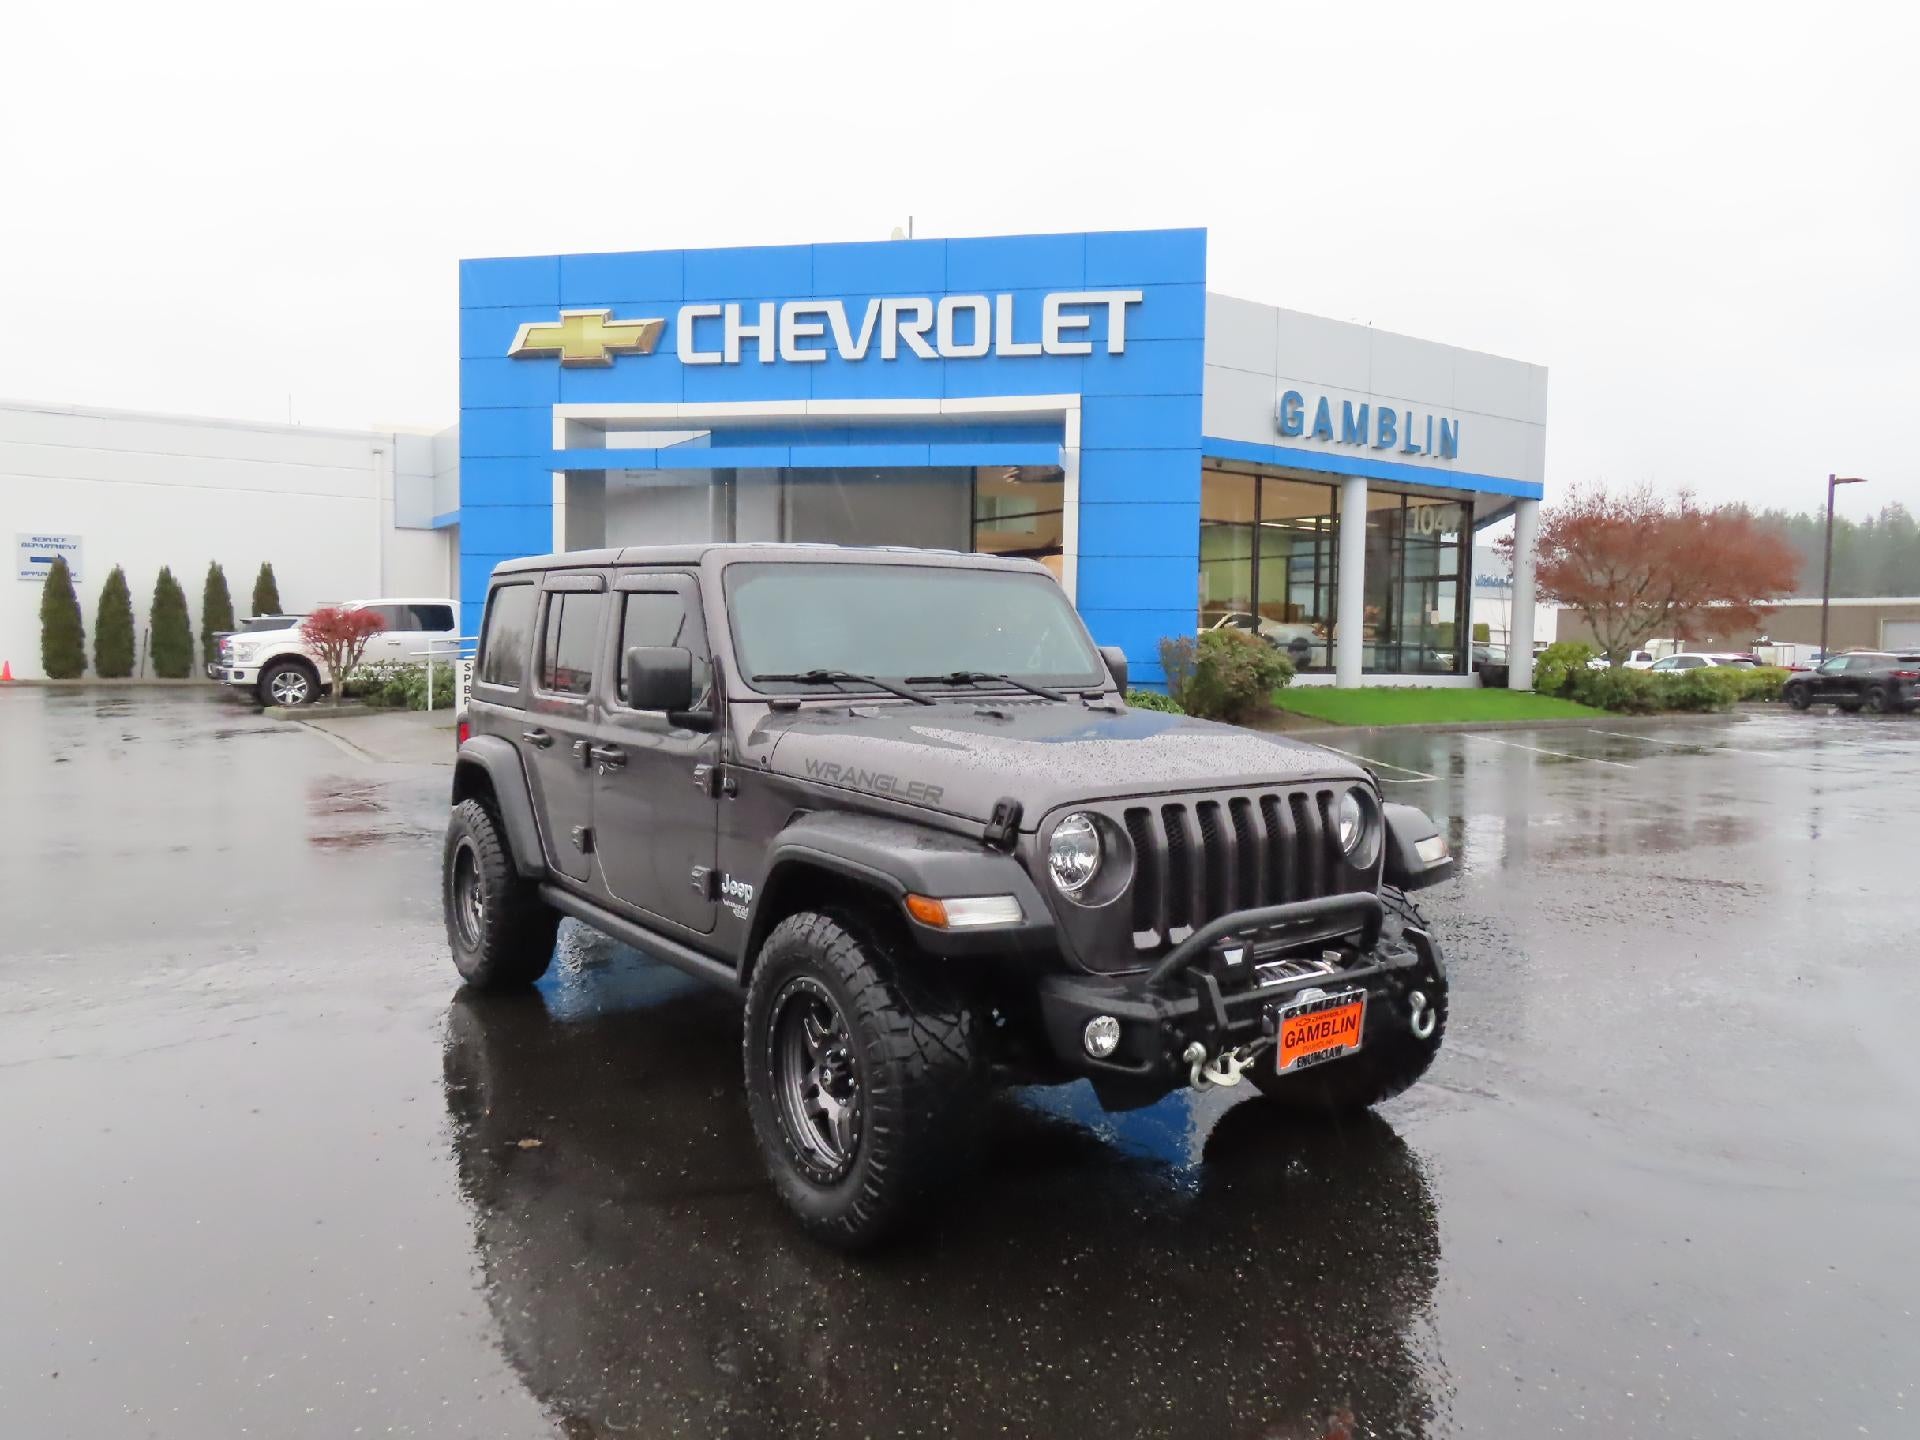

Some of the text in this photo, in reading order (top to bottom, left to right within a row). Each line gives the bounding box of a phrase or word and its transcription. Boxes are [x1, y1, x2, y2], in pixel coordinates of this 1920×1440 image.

[676, 290, 1144, 365] CHEVROLET
[1277, 389, 1460, 460] GAMBLIN
[805, 757, 945, 805] WRANGLER
[721, 873, 753, 904] Jeep
[1284, 1014, 1357, 1049] GAMBLIN
[1297, 1044, 1343, 1067] ENUMCLAW
